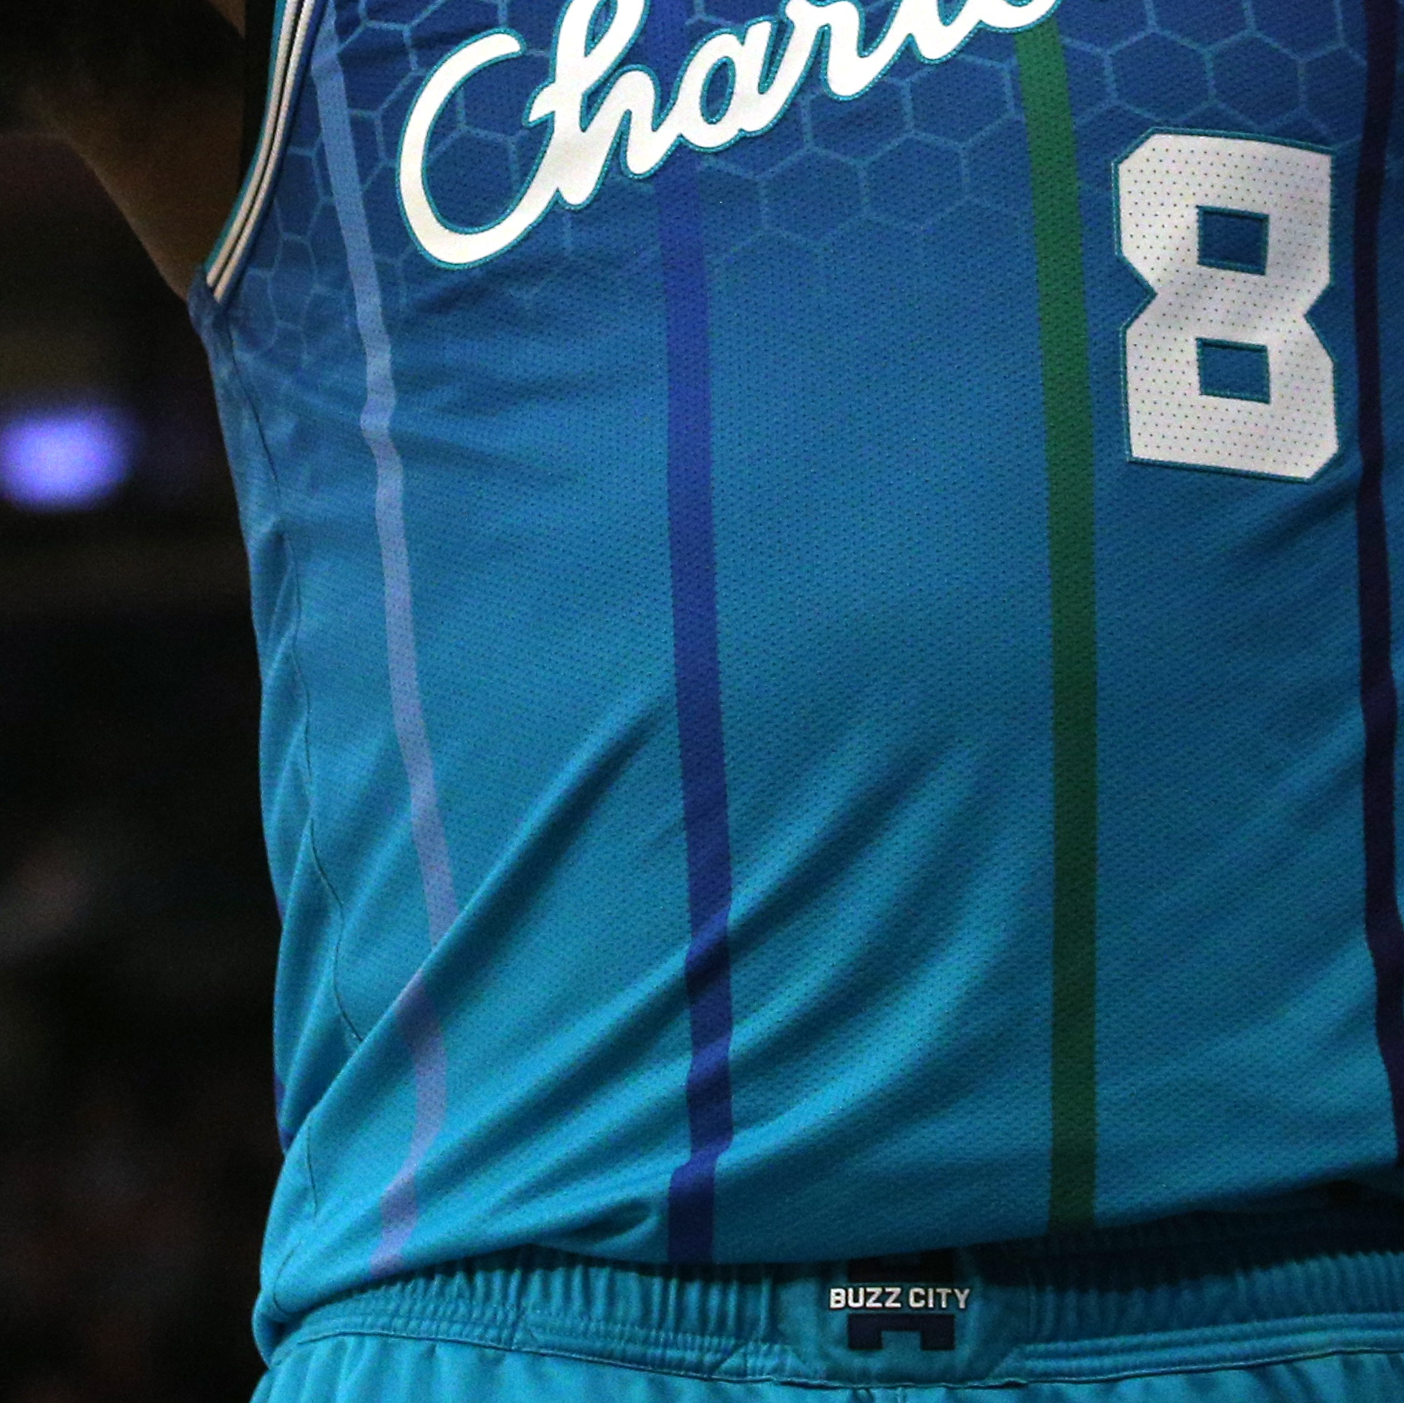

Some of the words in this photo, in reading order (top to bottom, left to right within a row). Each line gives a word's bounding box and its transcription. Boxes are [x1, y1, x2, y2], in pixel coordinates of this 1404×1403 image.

[1112, 128, 1339, 482] 8
[829, 1287, 902, 1309] BUZZ
[908, 1287, 971, 1309] CITY
